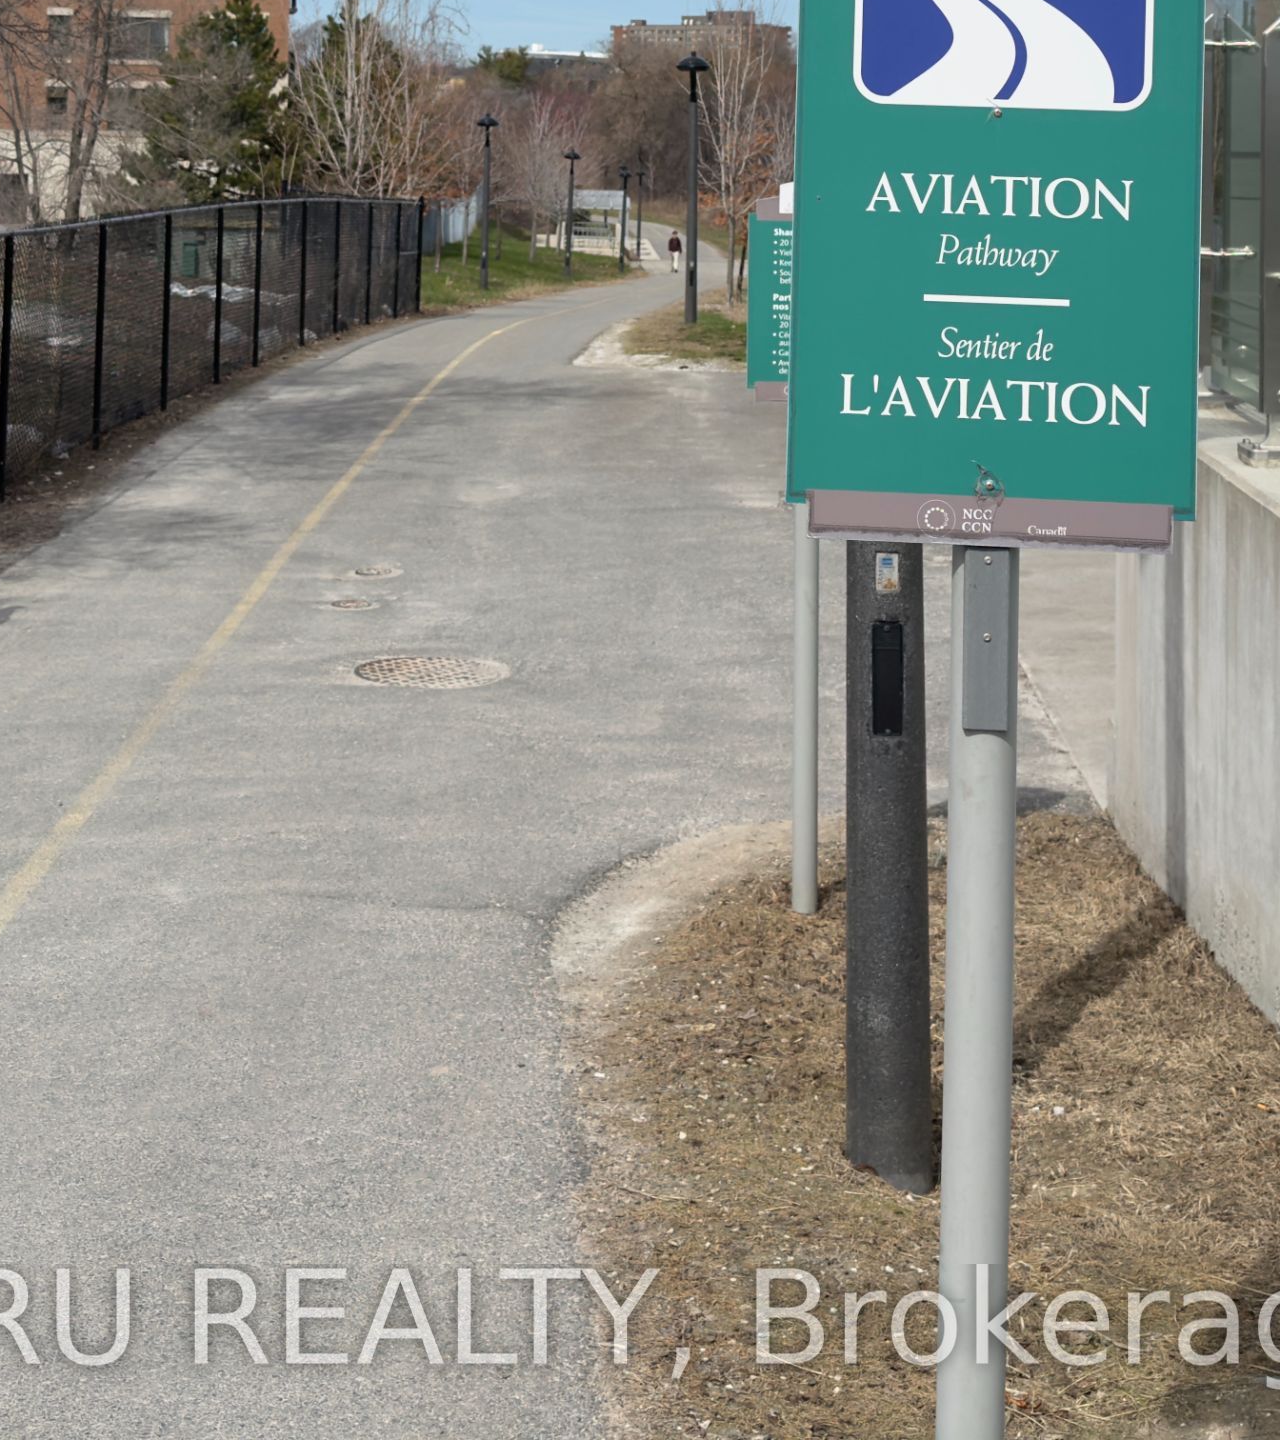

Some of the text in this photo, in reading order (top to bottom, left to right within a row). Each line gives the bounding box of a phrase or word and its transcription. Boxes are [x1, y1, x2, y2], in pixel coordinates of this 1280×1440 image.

[865, 171, 1134, 222] AVIATION
[935, 233, 1059, 277] Pathway
[937, 326, 1053, 361] Sentier de
[840, 373, 1150, 427] L'AVIATION
[961, 521, 993, 533] CCN
[962, 509, 993, 520] NCC
